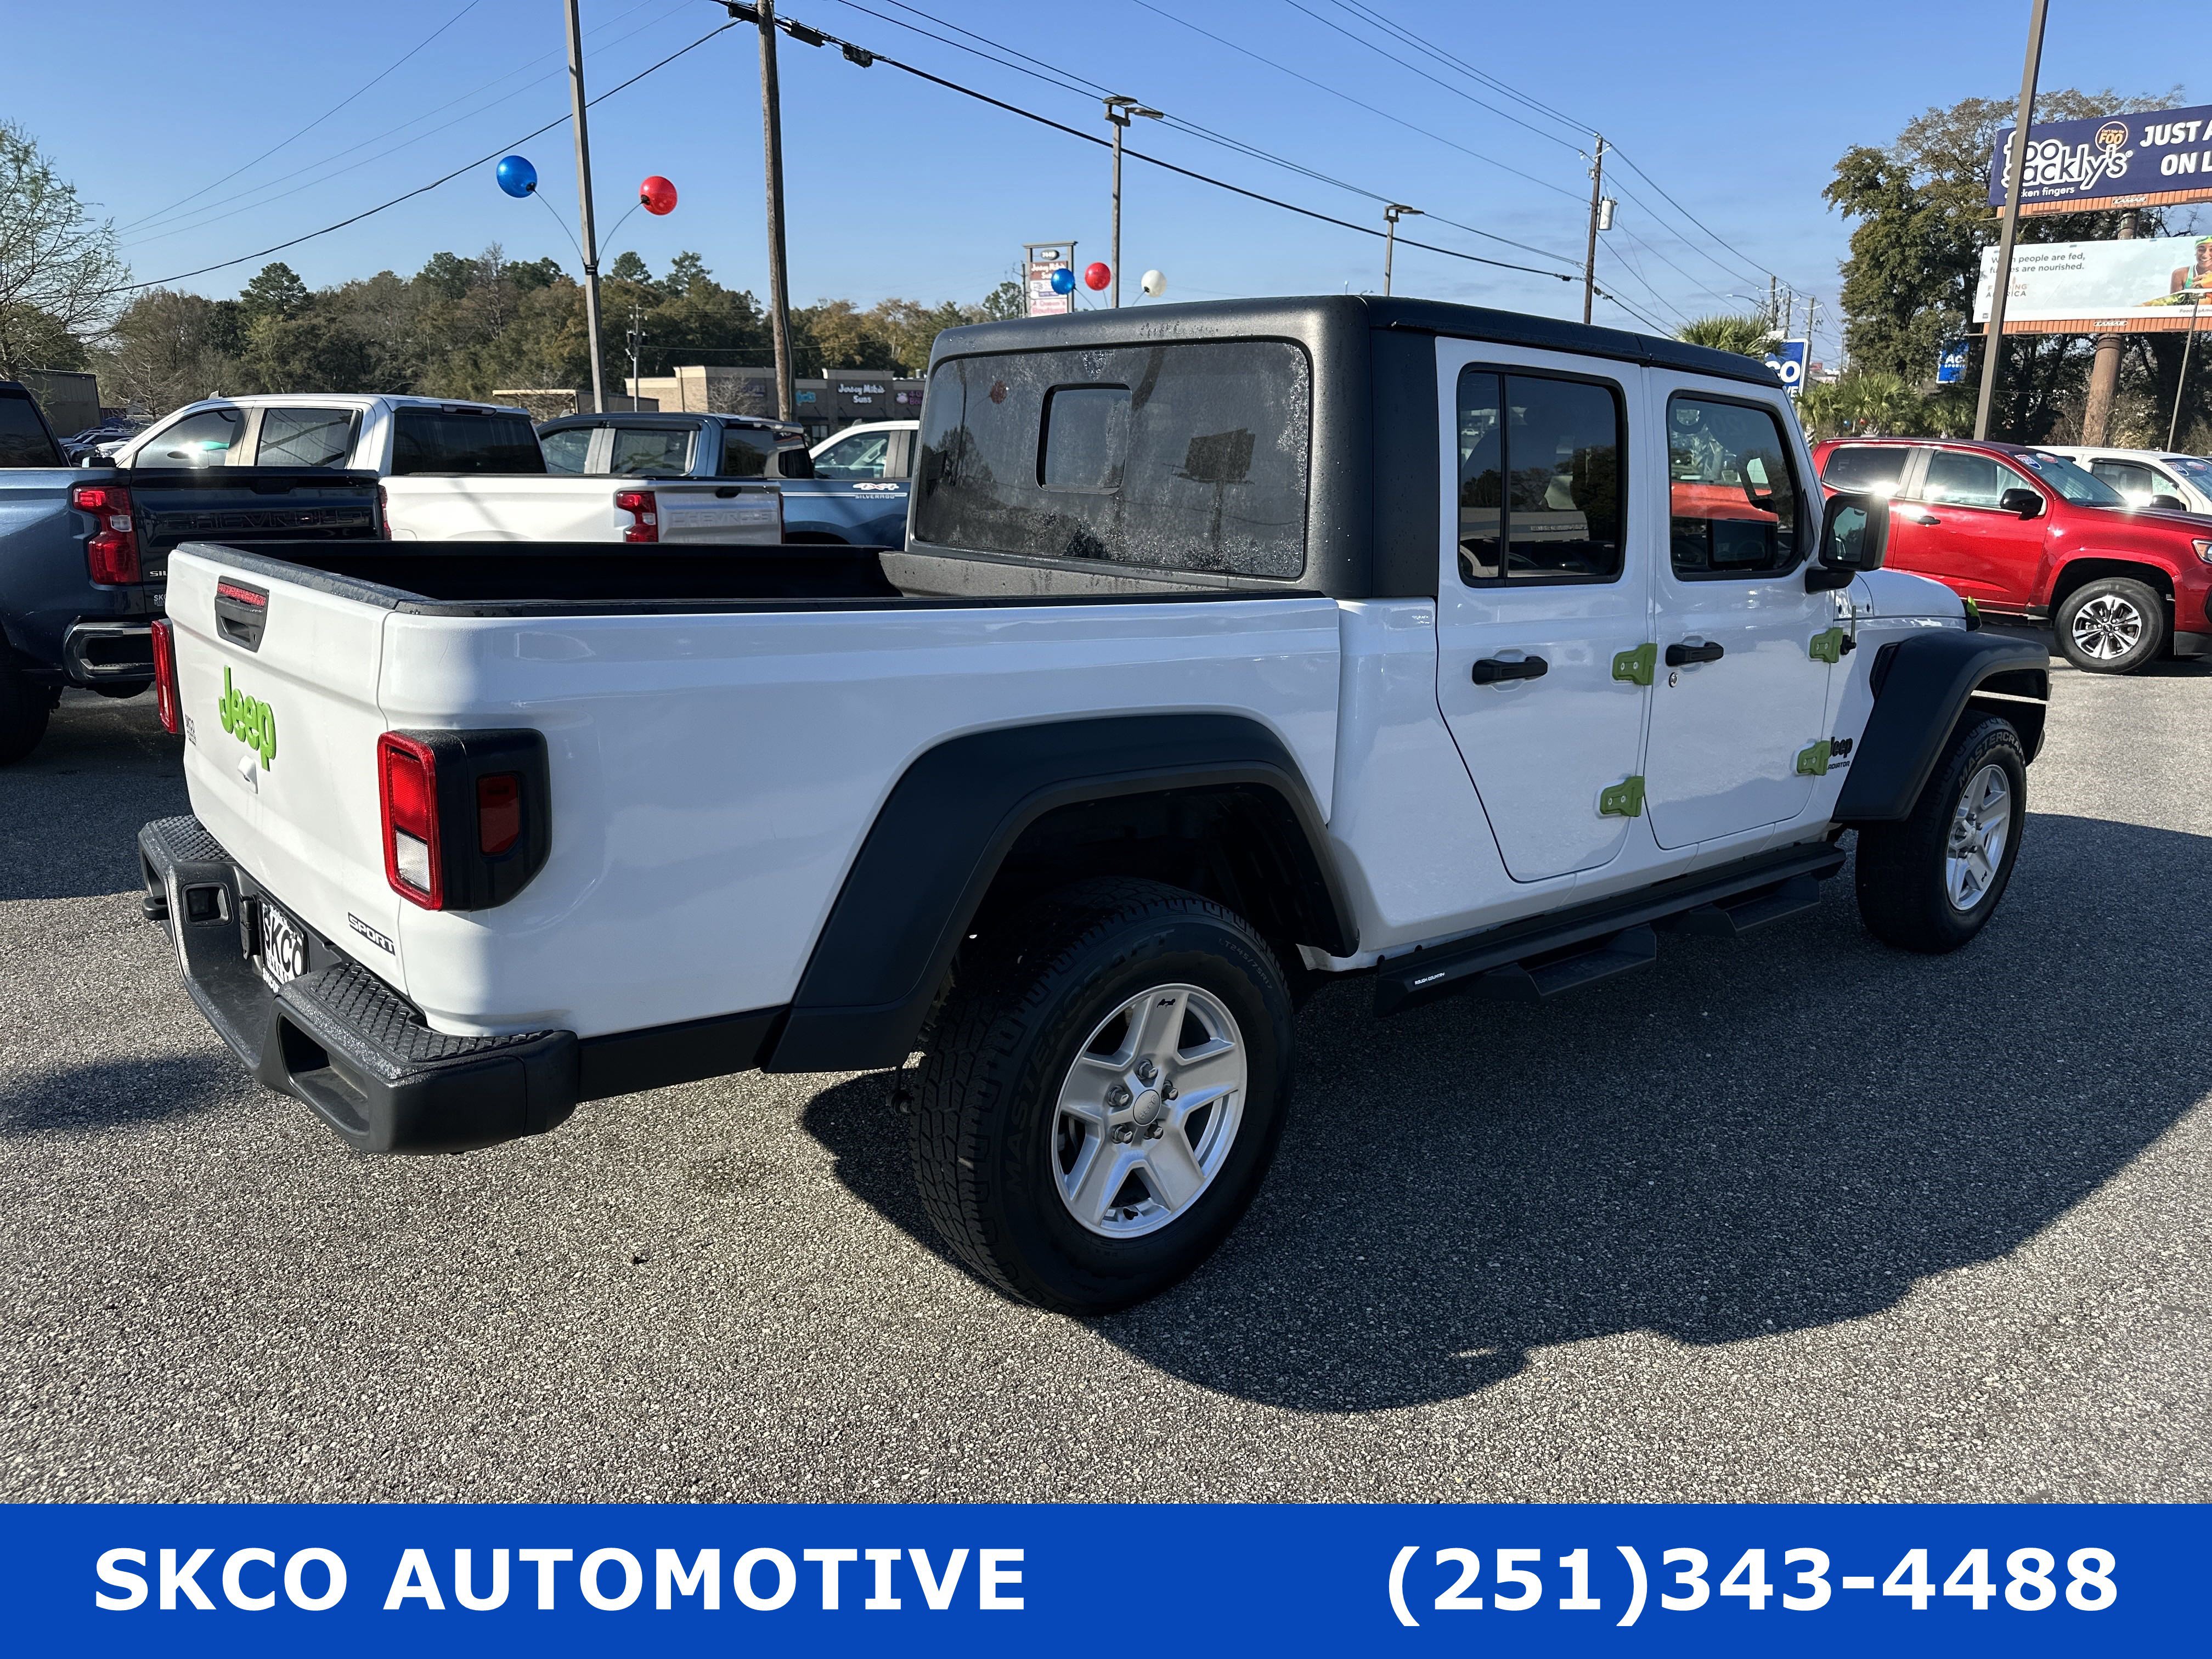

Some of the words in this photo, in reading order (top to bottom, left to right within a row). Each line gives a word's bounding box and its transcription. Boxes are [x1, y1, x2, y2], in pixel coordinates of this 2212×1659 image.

[2098, 133, 2123, 145] FOO
[2140, 121, 2202, 147] JUST
[2160, 151, 2197, 176] ON
[2042, 187, 2075, 197] fingers
[2019, 255, 2049, 263] people
[2038, 263, 2085, 271] nourished.
[838, 384, 862, 394] Jersey
[853, 395, 872, 404] Subs
[219, 665, 276, 772] Jeep
[1829, 736, 1853, 758] Jeep
[1826, 761, 1850, 770] ADIATOR
[349, 915, 393, 952] SPORT
[264, 911, 302, 979] SKCO
